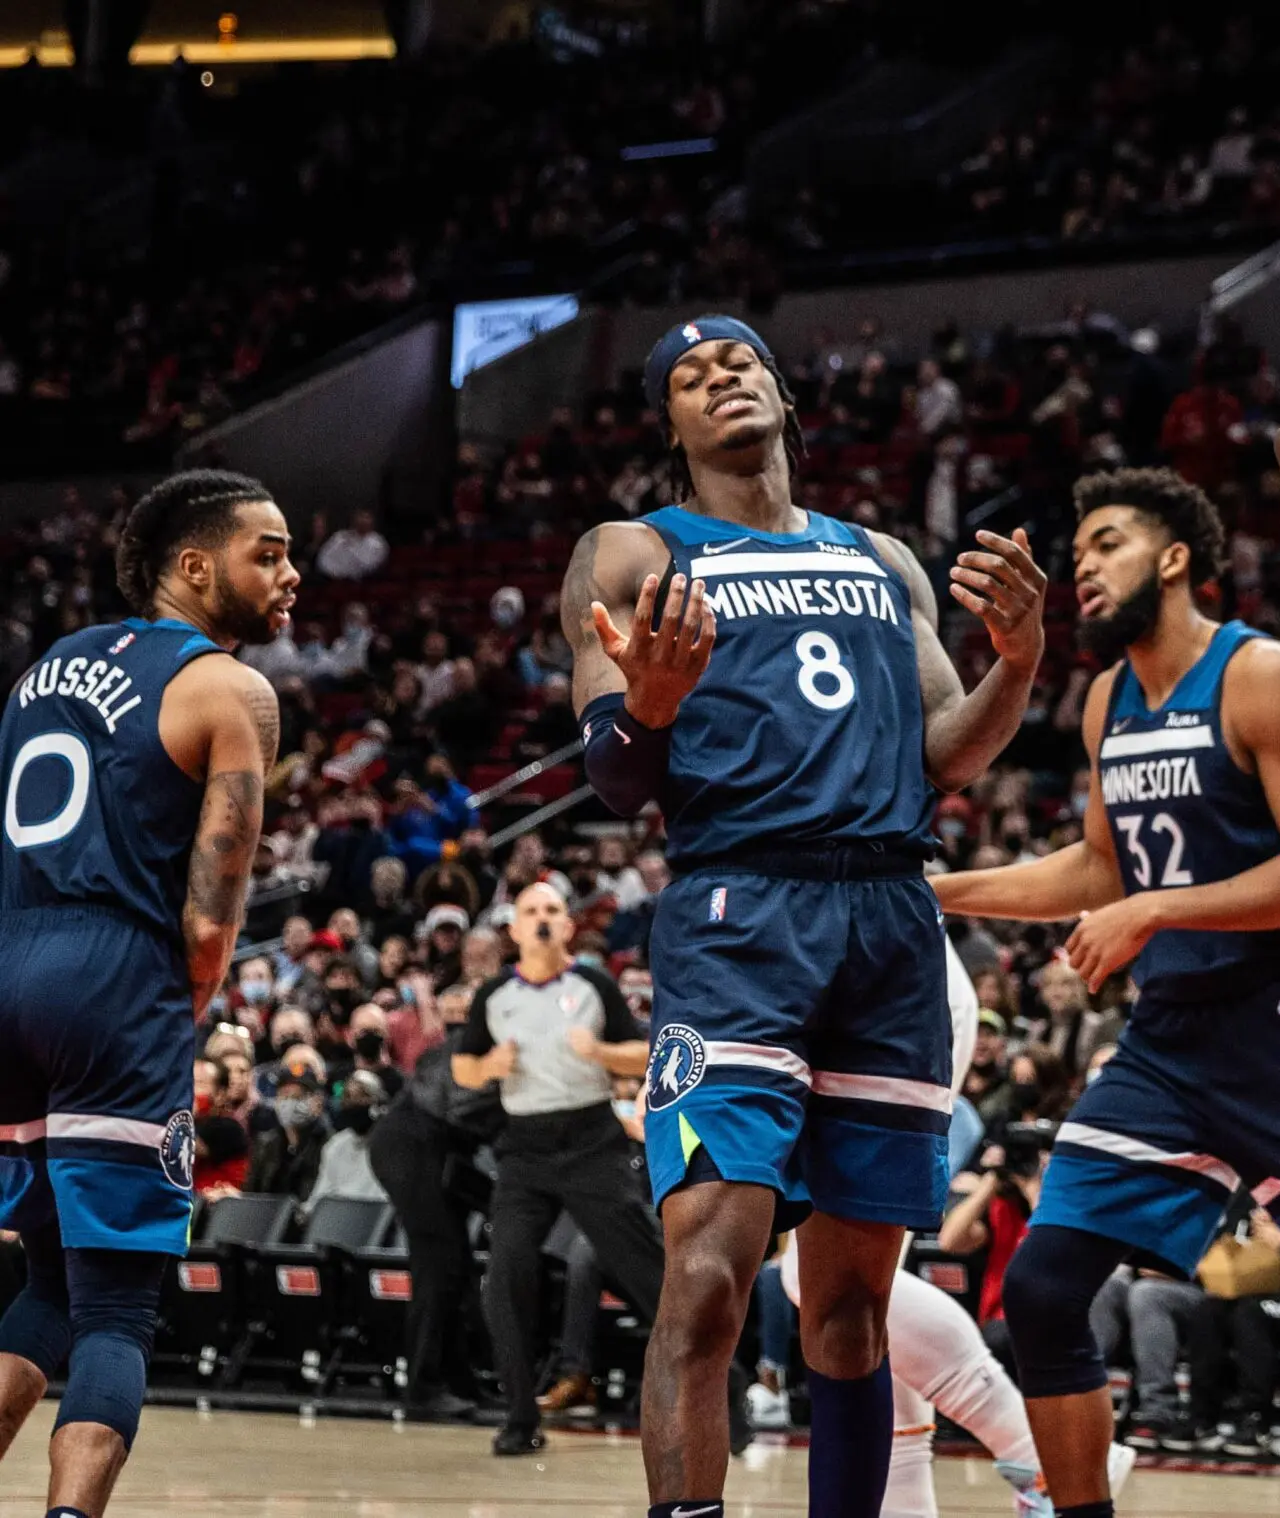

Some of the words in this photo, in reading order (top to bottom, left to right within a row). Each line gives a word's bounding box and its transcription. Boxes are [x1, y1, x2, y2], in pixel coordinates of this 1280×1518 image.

[702, 578, 898, 626] MINNESOTA
[19, 656, 142, 735] RUSSELL
[796, 630, 855, 711] 8
[5, 732, 90, 848] 0
[1102, 756, 1202, 805] MINNESOTA
[1115, 812, 1194, 887] 32
